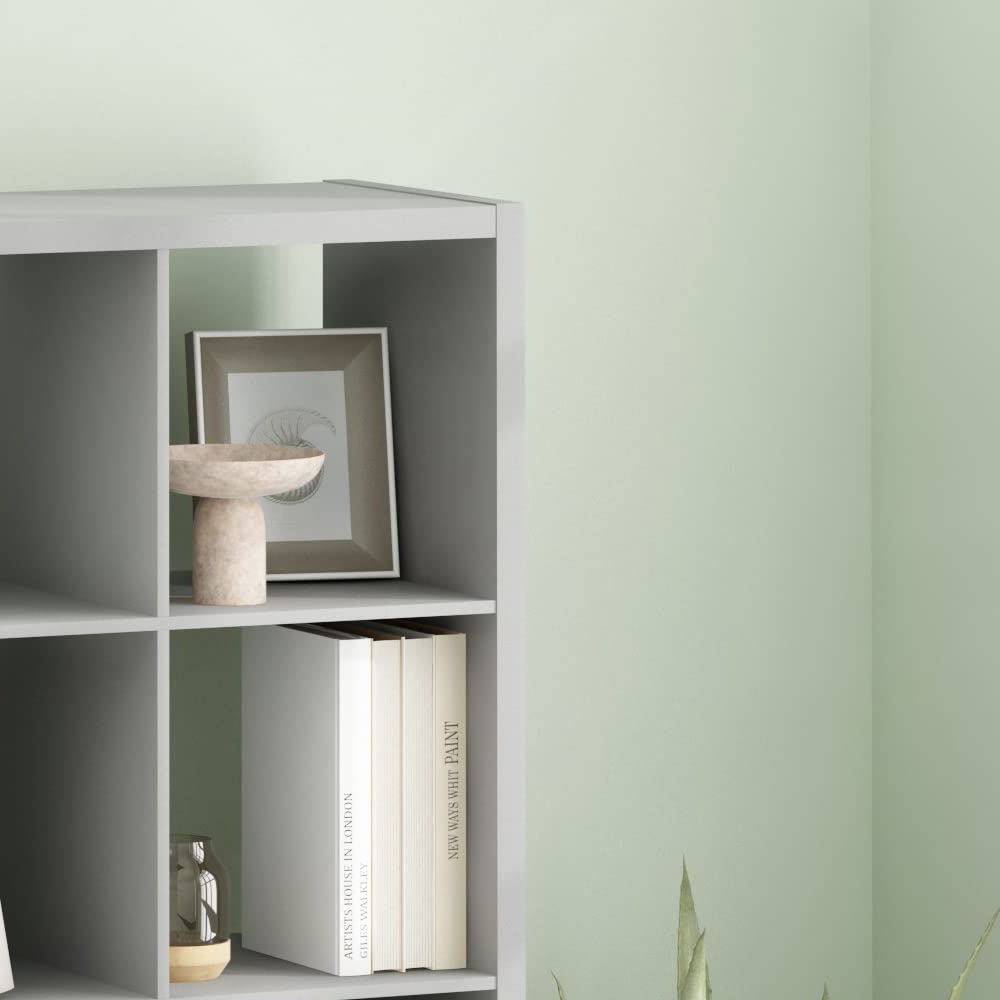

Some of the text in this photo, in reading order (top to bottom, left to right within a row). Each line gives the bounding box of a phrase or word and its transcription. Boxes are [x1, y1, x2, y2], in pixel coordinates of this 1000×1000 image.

[444, 721, 459, 860] NEW WAYS WHIT PAINT
[344, 793, 353, 960] ARTISTS HOUSE IN LONDON
[360, 863, 368, 959] GILES WALKLEY
